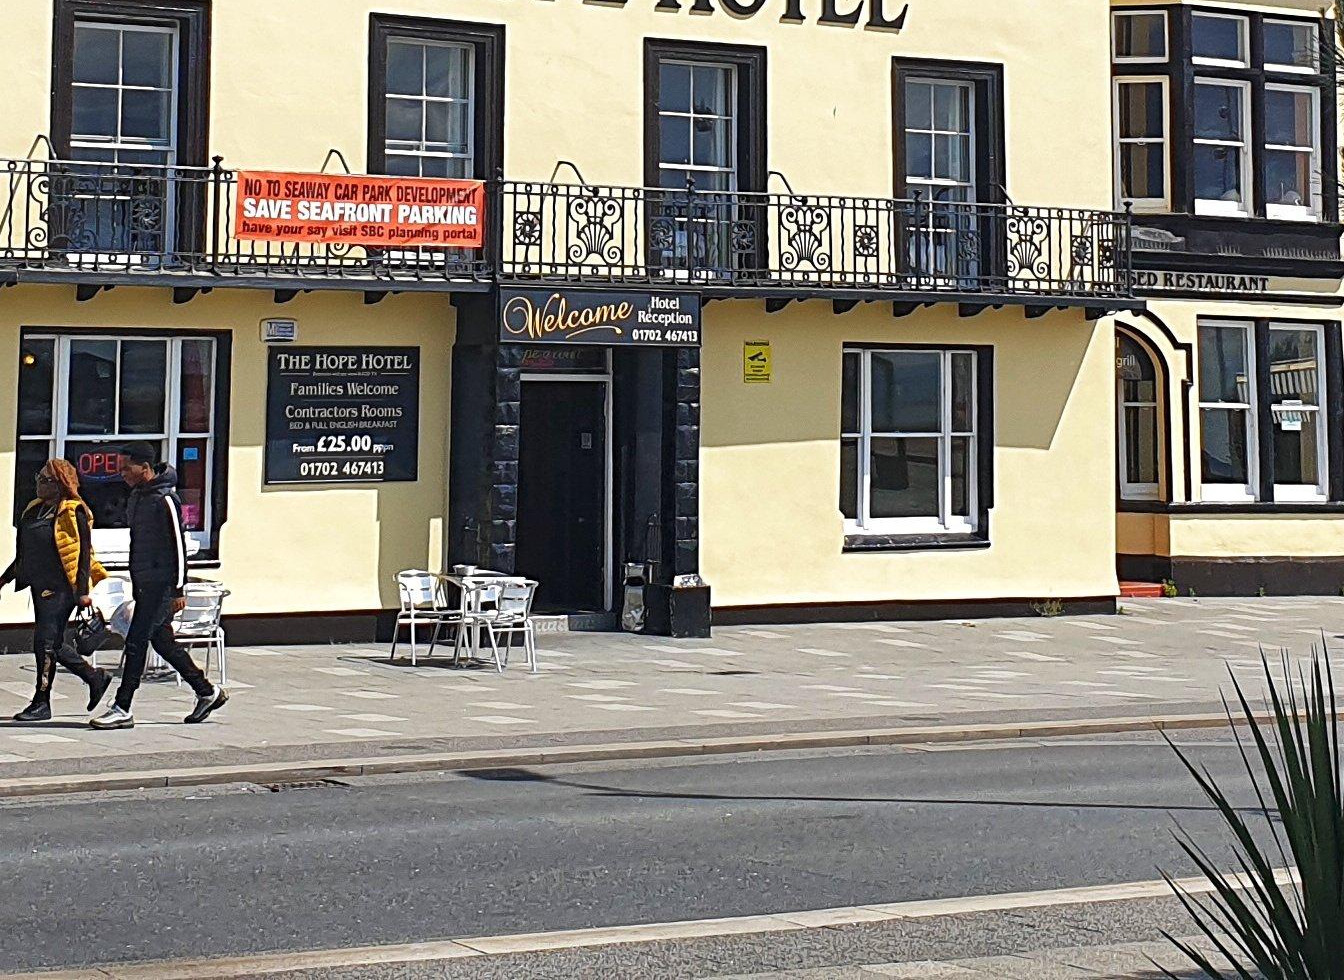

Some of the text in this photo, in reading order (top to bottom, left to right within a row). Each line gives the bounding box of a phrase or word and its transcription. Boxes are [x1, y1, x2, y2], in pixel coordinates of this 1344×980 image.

[244, 178, 477, 205] NO TO SEAWAY CAR PARK DEVELOPMENT
[243, 198, 477, 224] SAVE SEAFRONT PARKING
[242, 220, 477, 241] have your say visit SBC planning portal
[1164, 272, 1269, 291] RESTAURANT
[651, 296, 679, 310] Hotel
[503, 293, 634, 339] Welcome
[638, 310, 692, 326] Reception
[632, 329, 698, 342] 01702 467413
[277, 354, 412, 369] THE HOPE HOTEL
[1116, 355, 1136, 368] grill
[290, 382, 399, 396] Families Welcome
[285, 405, 403, 418] Contractors Rooms
[289, 420, 397, 429] BED & FULL ENGLISH BREAKFAST
[292, 443, 315, 453] From
[317, 435, 371, 452] £25.00
[300, 461, 384, 476] 01702 467413
